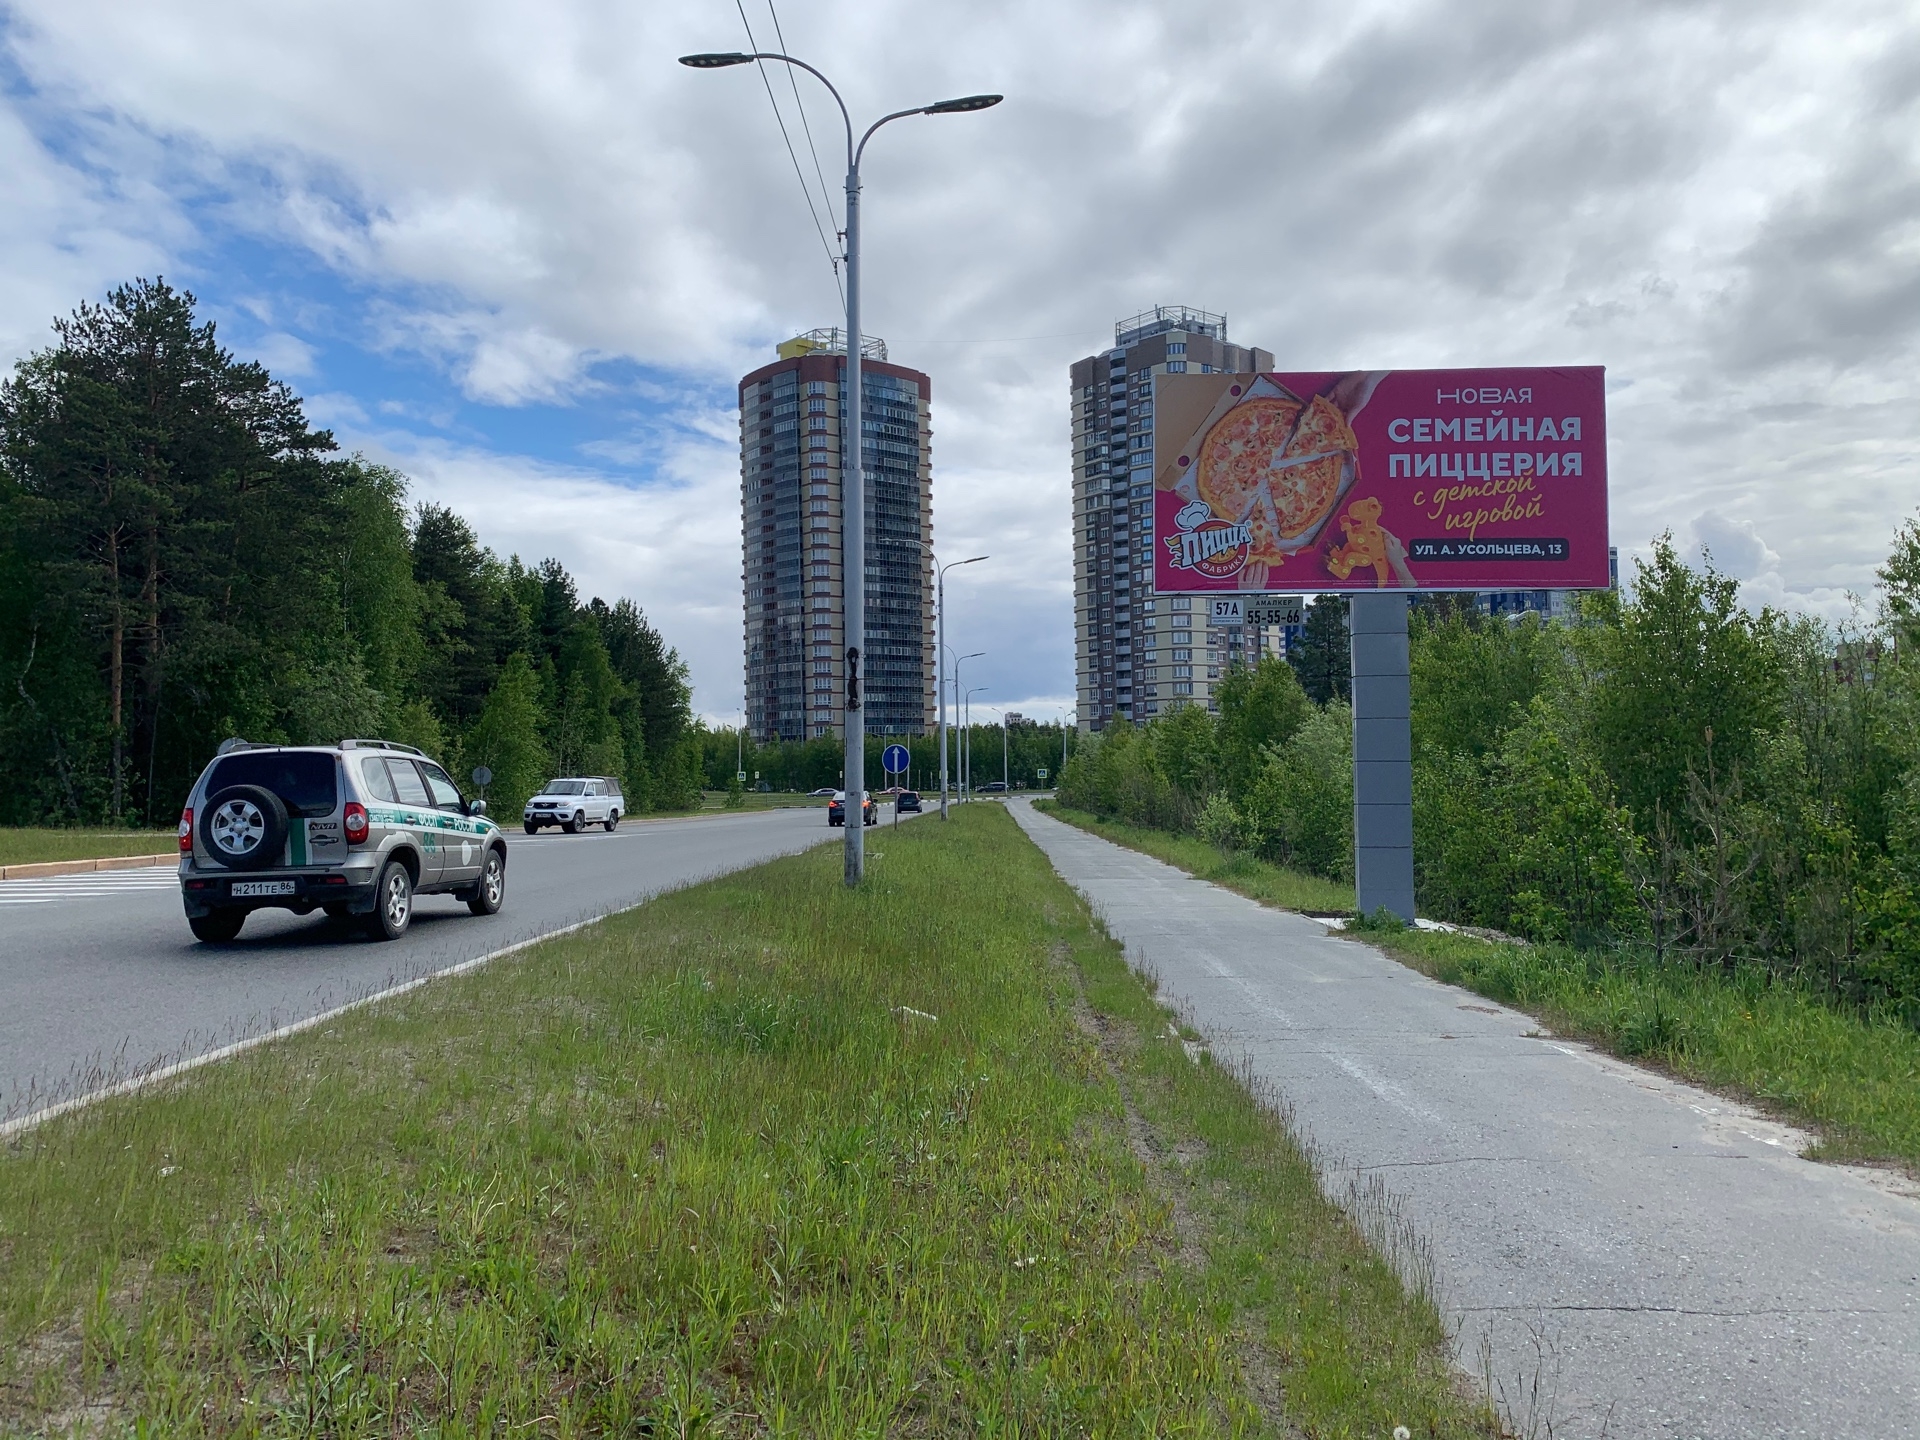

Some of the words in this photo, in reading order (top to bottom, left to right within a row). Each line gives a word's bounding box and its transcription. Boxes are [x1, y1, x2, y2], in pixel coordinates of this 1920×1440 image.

[1437, 387, 1532, 404] НОВАЯ
[1388, 410, 1582, 443] СЕМЕЙНАЯ
[1389, 452, 1583, 481] ПИЦЦЕРИЯ
[1413, 490, 1426, 506] с
[1427, 468, 1537, 520] детской
[1445, 493, 1545, 542] игровой
[1181, 526, 1252, 568] ПИЦЦА
[1415, 545, 1437, 555] УЛ.
[1441, 545, 1455, 555] А.
[1458, 544, 1545, 556] УСОЛЬЦЕВА,
[1548, 544, 1563, 555] 13
[1201, 554, 1245, 574] ФАБРИКА
[1255, 599, 1293, 607] АМАЛКЕР
[1247, 609, 1300, 625] 55-55-66
[418, 813, 438, 828] ФССП
[423, 832, 436, 853] 86
